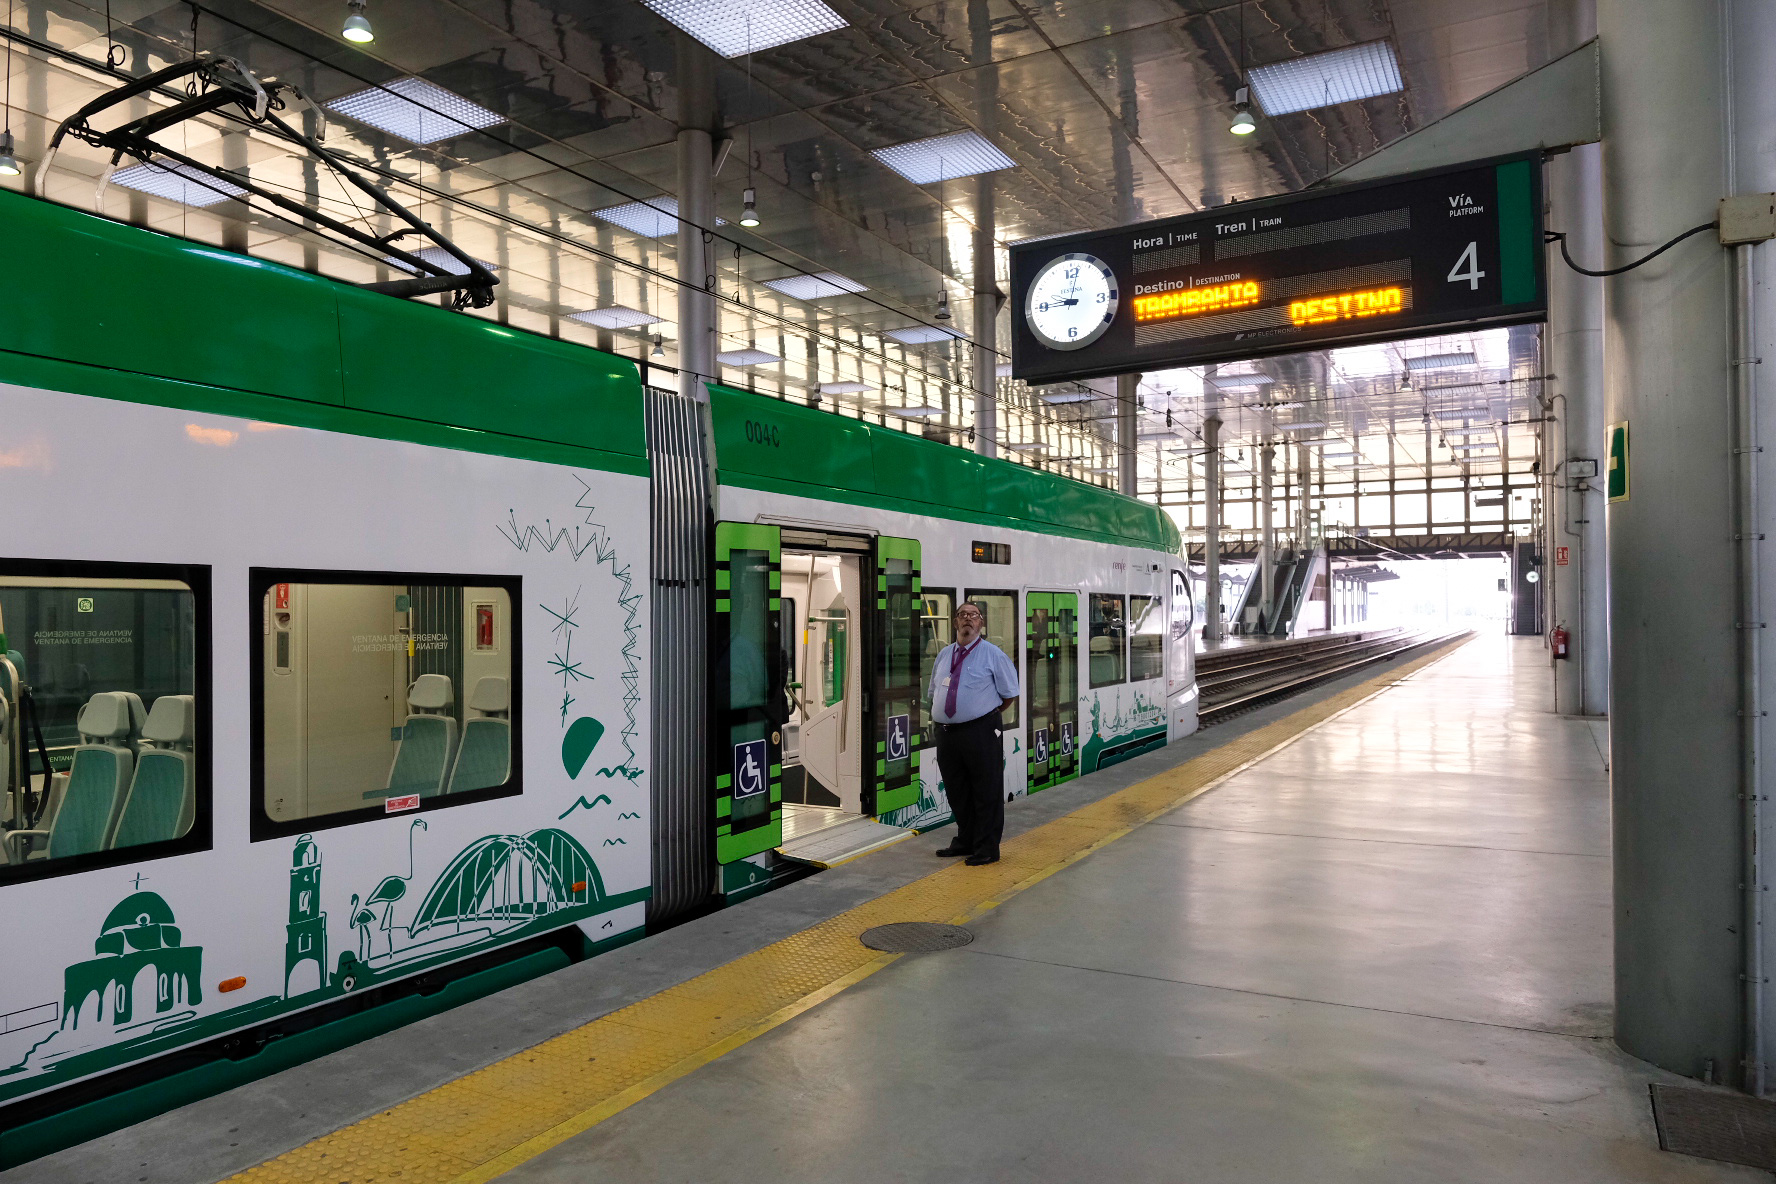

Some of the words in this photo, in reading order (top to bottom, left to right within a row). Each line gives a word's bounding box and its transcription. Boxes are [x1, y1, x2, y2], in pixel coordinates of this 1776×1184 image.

[1449, 206, 1484, 217] PLATFORM
[1215, 222, 1246, 235] Tren
[1259, 217, 1282, 228] TRAIN
[1133, 237, 1163, 250] Hora
[1176, 232, 1198, 242] TIME
[1447, 241, 1485, 290] 4
[1064, 267, 1080, 279] 12
[1134, 279, 1184, 295] Destino
[1195, 273, 1241, 286] DESTINATION
[1096, 292, 1106, 303] 3
[1039, 301, 1049, 312] 9
[1067, 326, 1078, 338] 6
[1257, 327, 1302, 337] ELECTRONICS
[745, 420, 780, 448] 004C
[352, 635, 388, 643] VENTANA
[389, 634, 399, 642] DE
